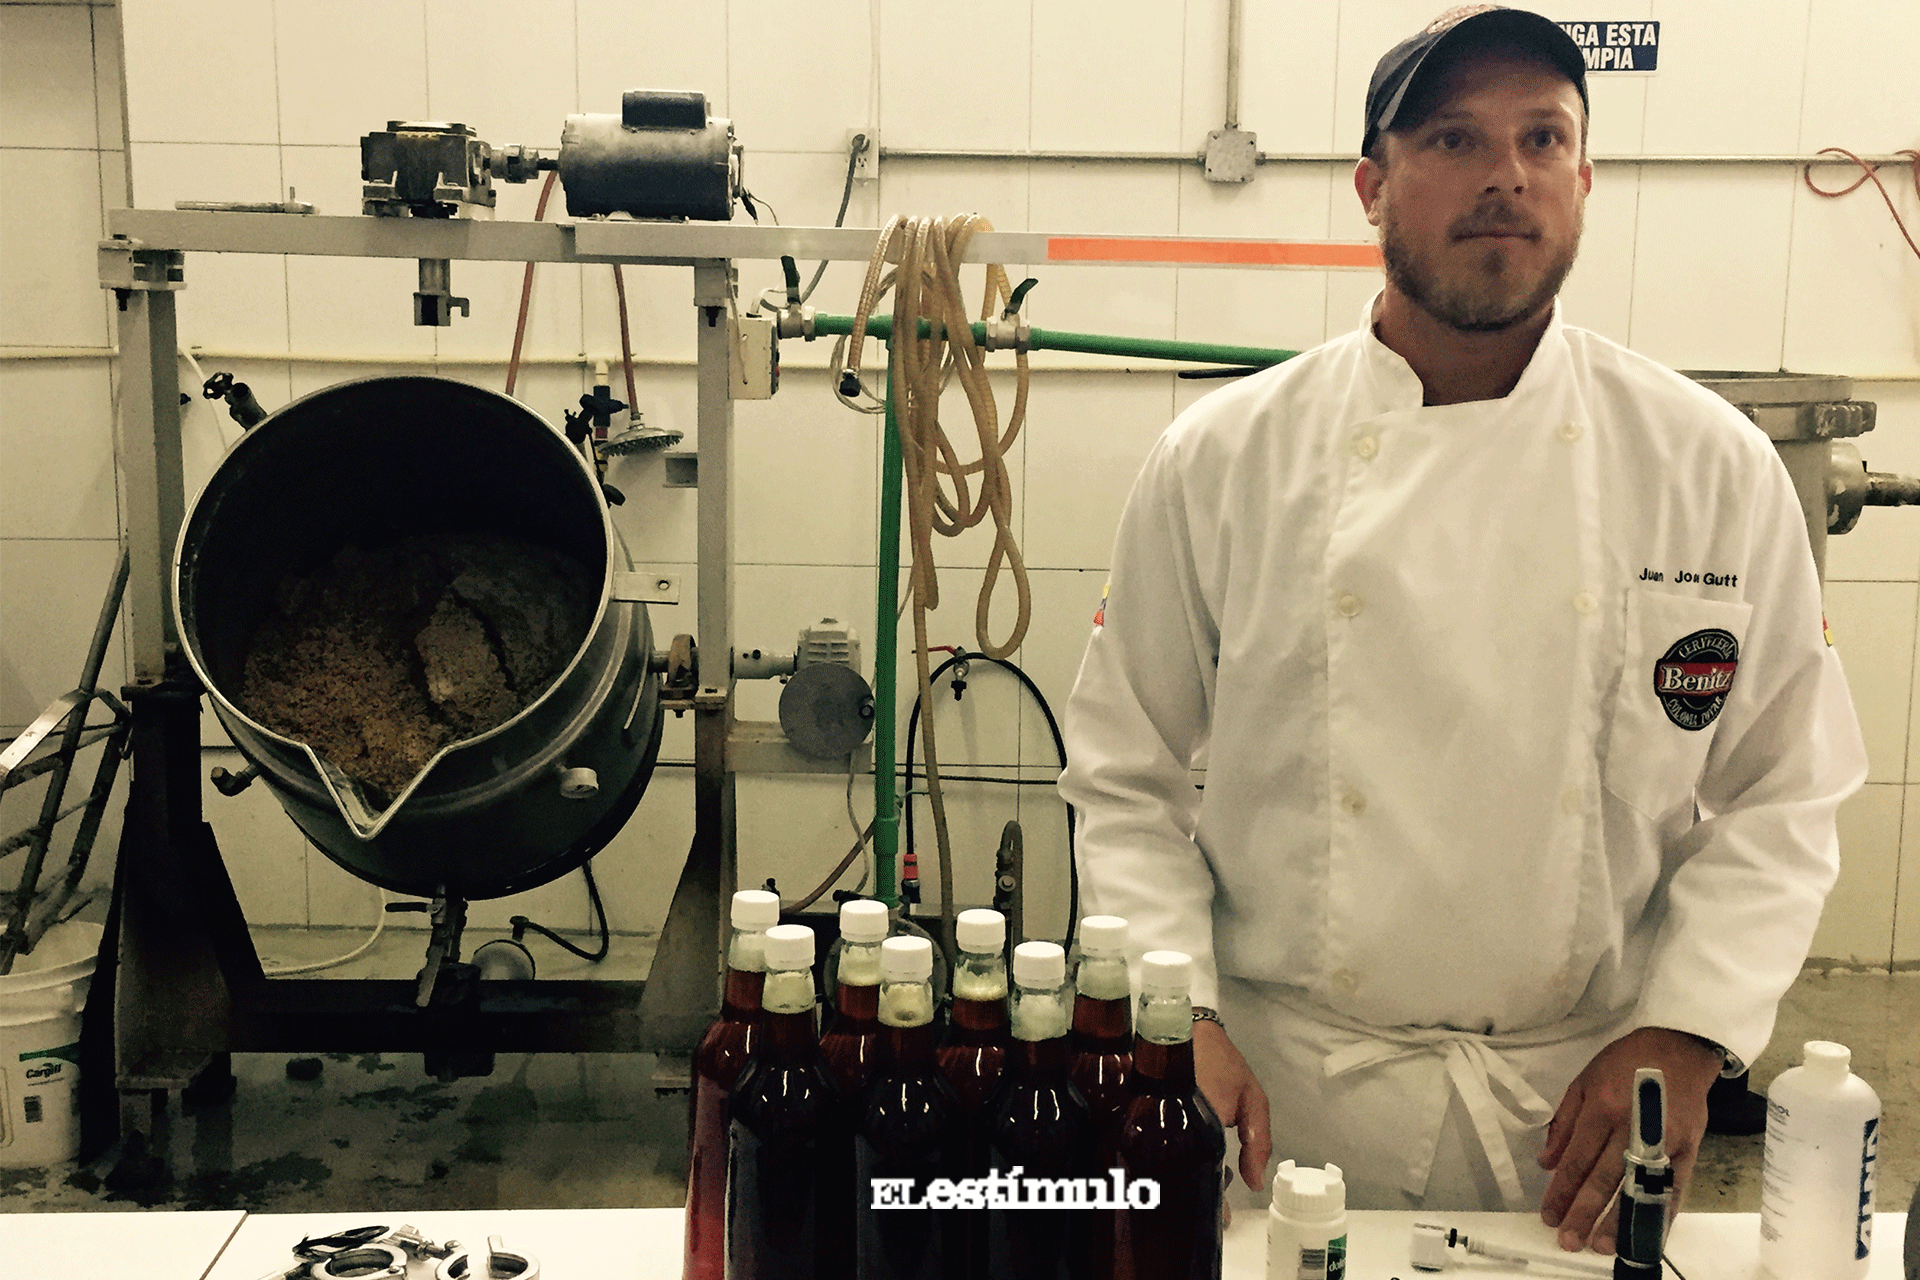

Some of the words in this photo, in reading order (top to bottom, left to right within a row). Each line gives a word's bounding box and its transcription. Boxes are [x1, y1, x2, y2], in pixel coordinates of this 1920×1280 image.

[1606, 24, 1656, 46] ESTA
[1639, 567, 1664, 582] Juan
[1703, 572, 1738, 587] Gutt
[1661, 667, 1731, 691] Benitz
[26, 1062, 64, 1079] Cargill
